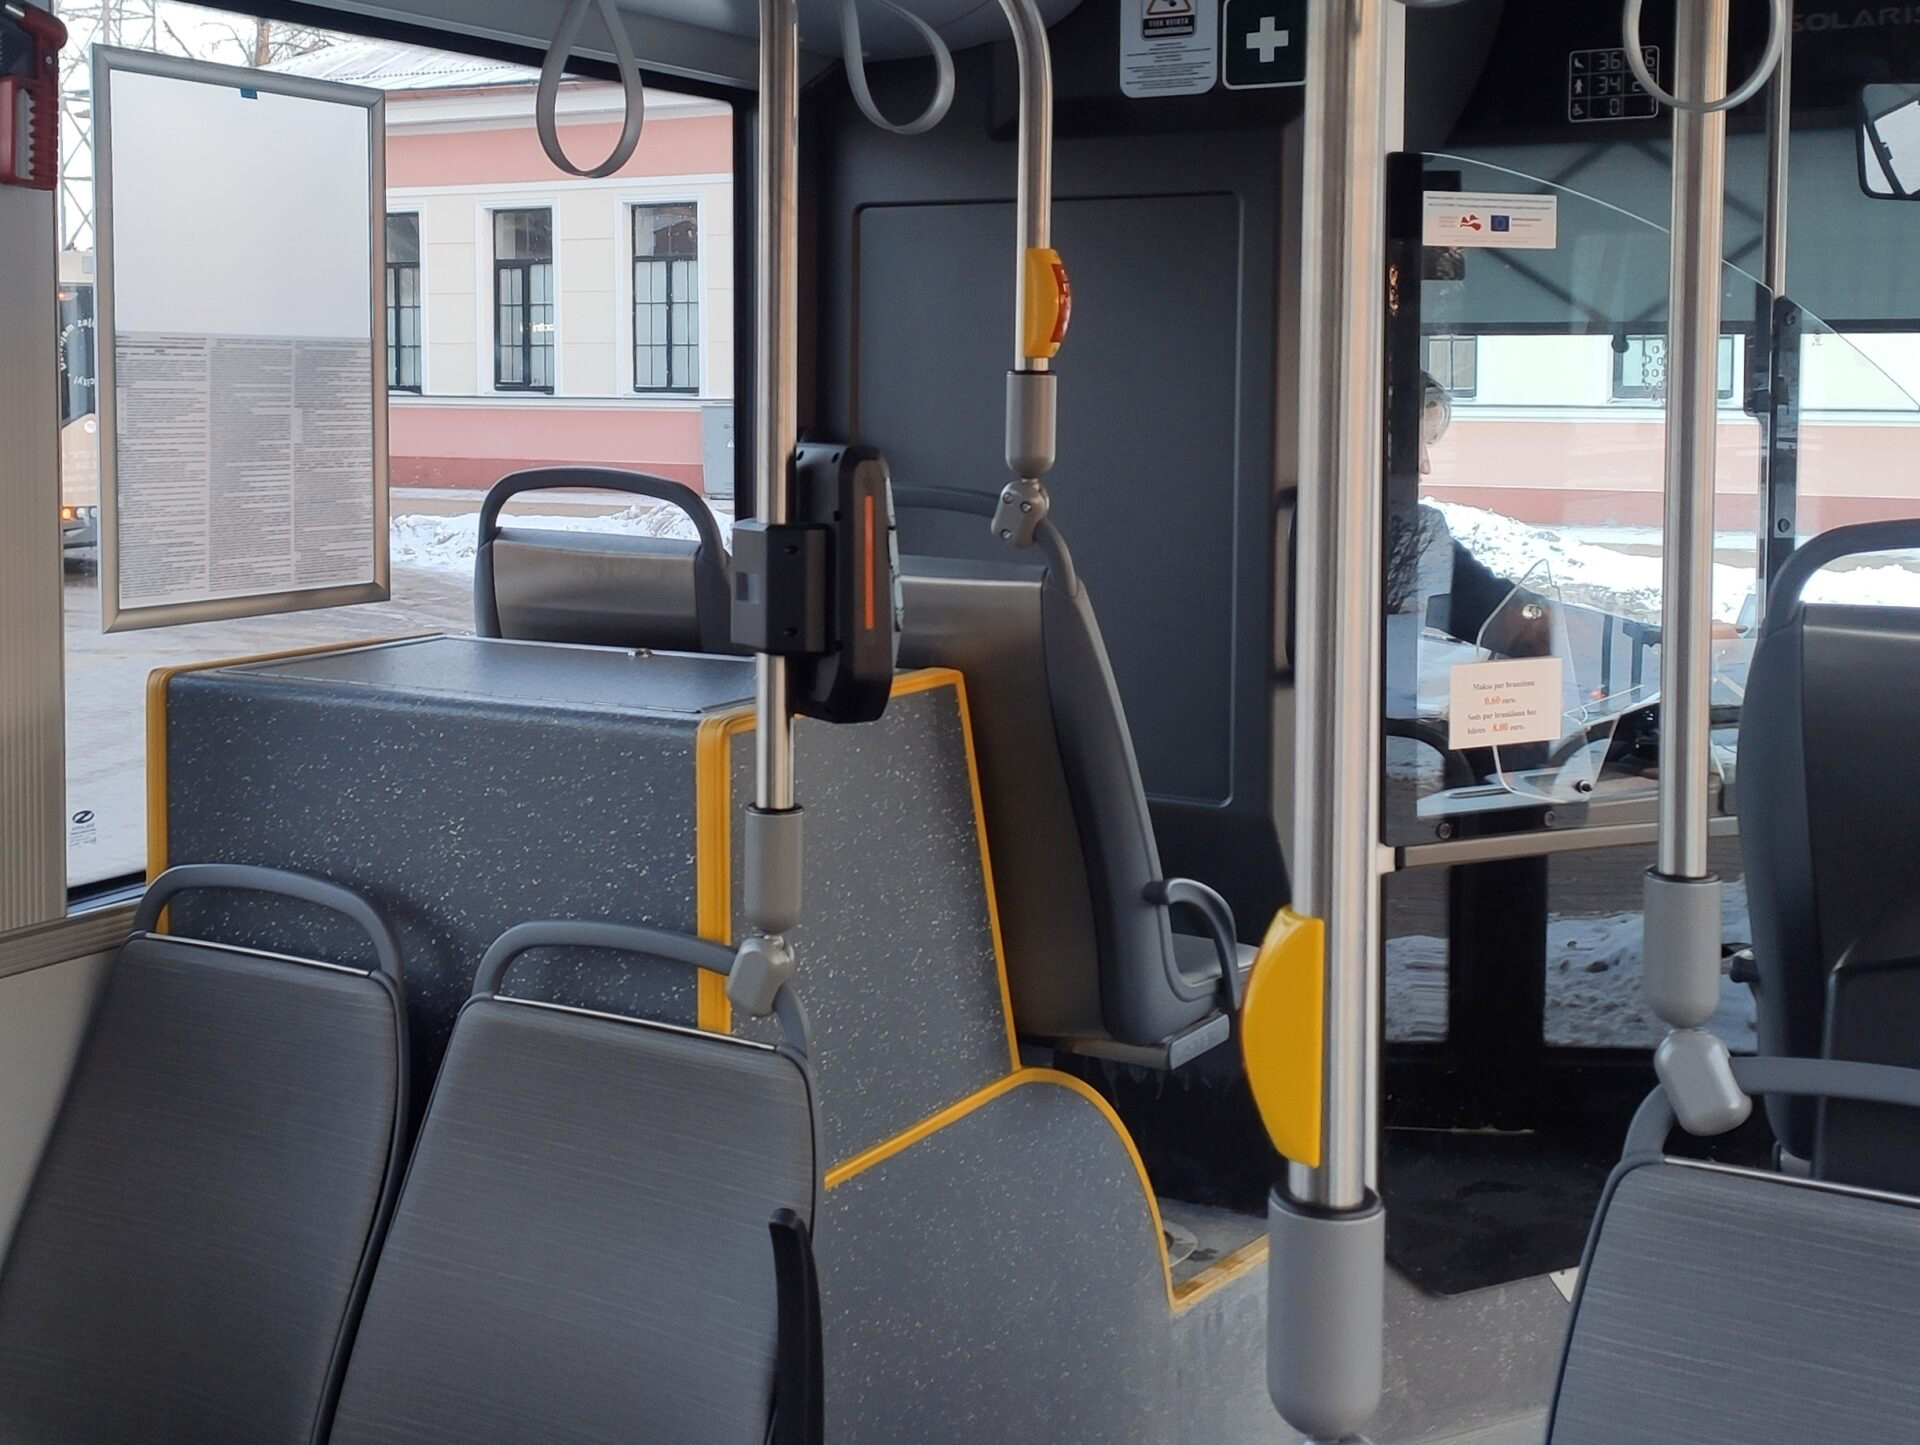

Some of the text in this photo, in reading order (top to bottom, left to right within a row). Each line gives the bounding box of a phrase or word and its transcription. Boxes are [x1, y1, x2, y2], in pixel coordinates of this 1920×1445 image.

[1597, 51, 1620, 71] 36
[1597, 75, 1621, 95] 34
[1494, 682, 1504, 691] par
